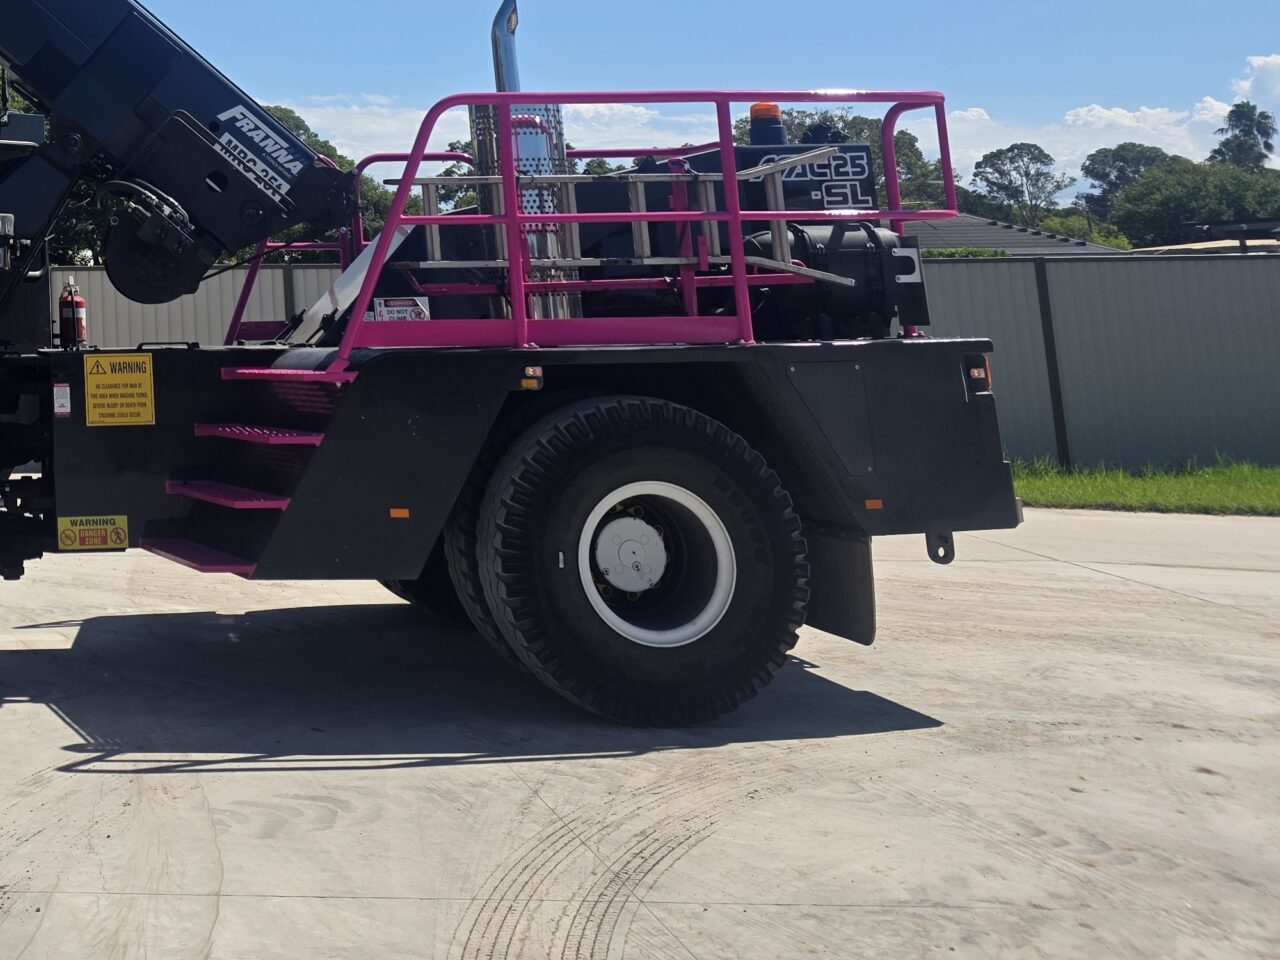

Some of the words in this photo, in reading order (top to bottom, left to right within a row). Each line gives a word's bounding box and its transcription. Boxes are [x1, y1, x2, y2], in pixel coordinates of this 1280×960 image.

[216, 105, 304, 176] FRANNA
[110, 361, 147, 374] WARNING
[70, 518, 116, 528] WARNING
[81, 529, 105, 537] DANGER
[85, 537, 102, 545] ZONE
